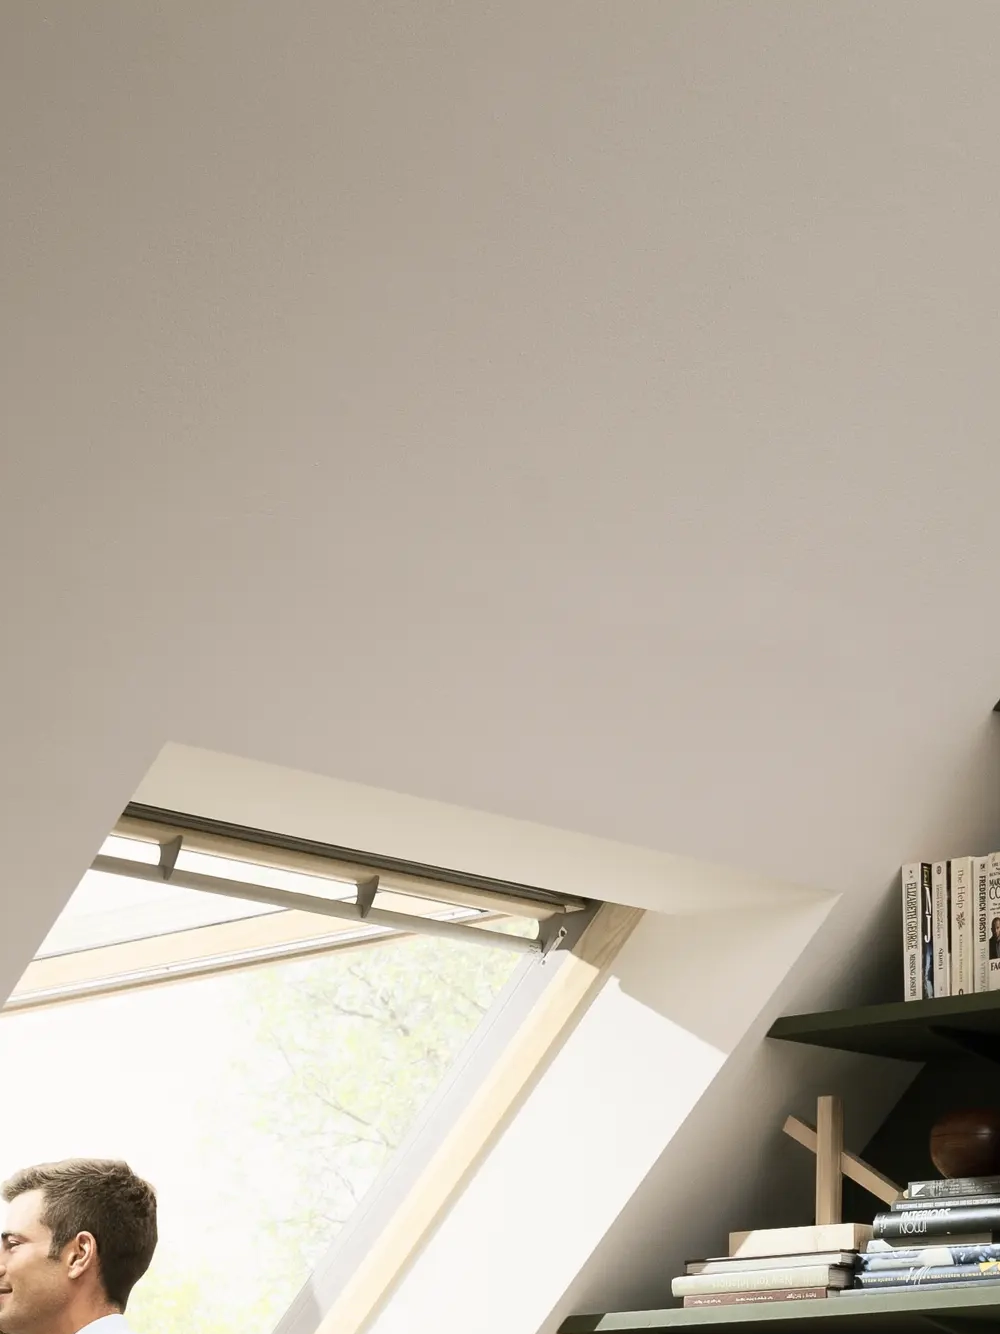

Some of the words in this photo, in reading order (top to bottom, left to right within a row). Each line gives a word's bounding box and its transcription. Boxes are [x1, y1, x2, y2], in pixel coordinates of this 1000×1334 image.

[905, 882, 918, 921] ELIZABETH
[956, 886, 965, 909] Help
[979, 875, 987, 911] FREDERICK
[906, 921, 919, 952] GEORGE
[979, 911, 987, 943] FORSYTH
[909, 953, 917, 976] MISSING
[909, 976, 917, 997] JOSEPH
[900, 1208, 951, 1219] INTERIORS
[899, 1220, 928, 1234] NOW!
